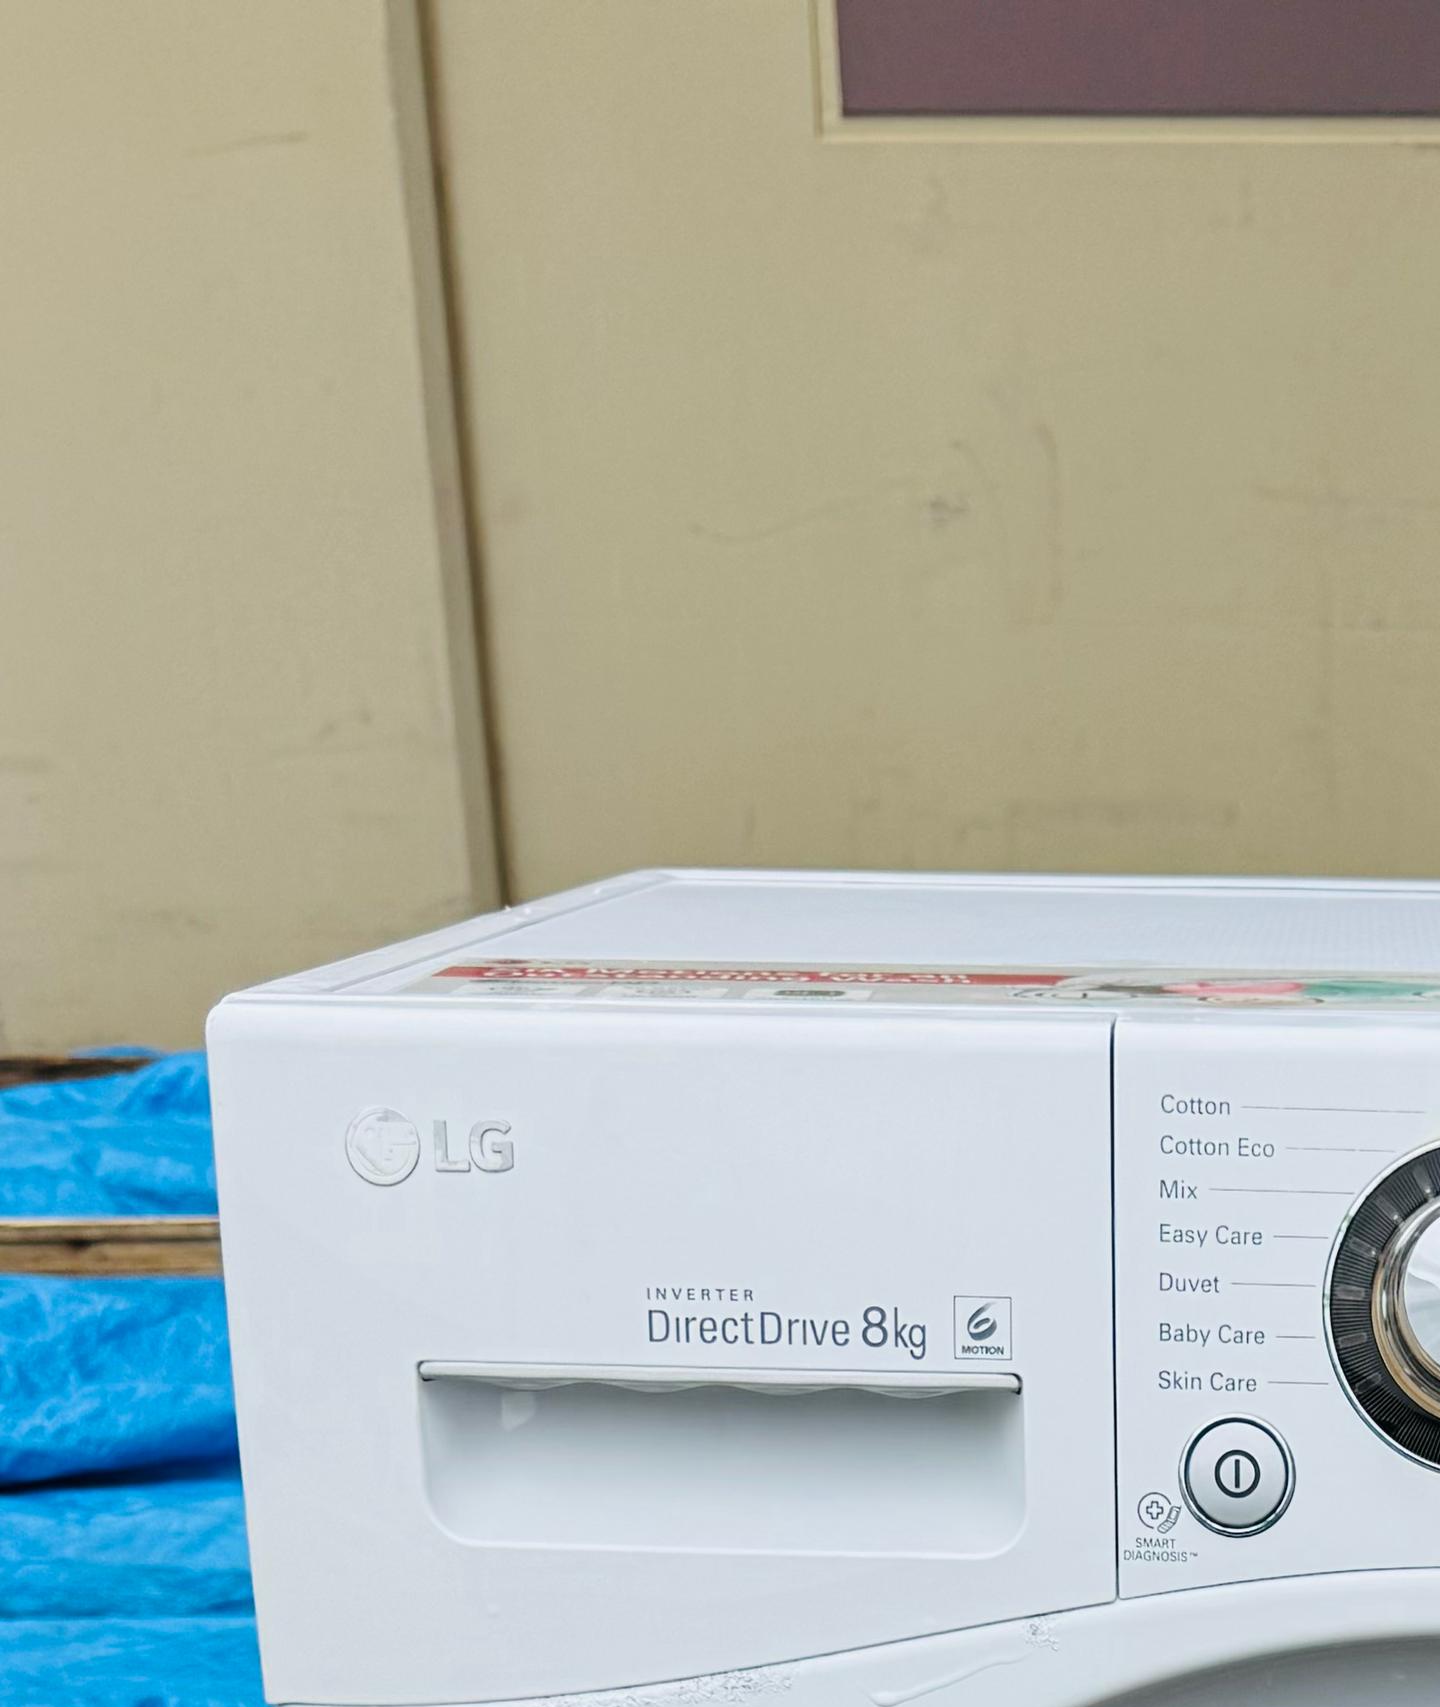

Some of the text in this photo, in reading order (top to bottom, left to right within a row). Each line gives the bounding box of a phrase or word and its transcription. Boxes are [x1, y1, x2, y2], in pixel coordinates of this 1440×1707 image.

[1160, 1096, 1231, 1118] Cotton
[433, 1119, 515, 1173] LG
[1159, 1136, 1276, 1158] Cotton Eco
[1159, 1178, 1199, 1200] Mix
[1158, 1224, 1264, 1249] Easy Care
[646, 1288, 754, 1301] INVERTER
[1158, 1272, 1220, 1295] Duvet
[1158, 1323, 1266, 1348] Baby Care
[962, 1345, 1004, 1356] MOTION
[1158, 1371, 1258, 1393] Skin Care
[1136, 1537, 1176, 1549] SMART
